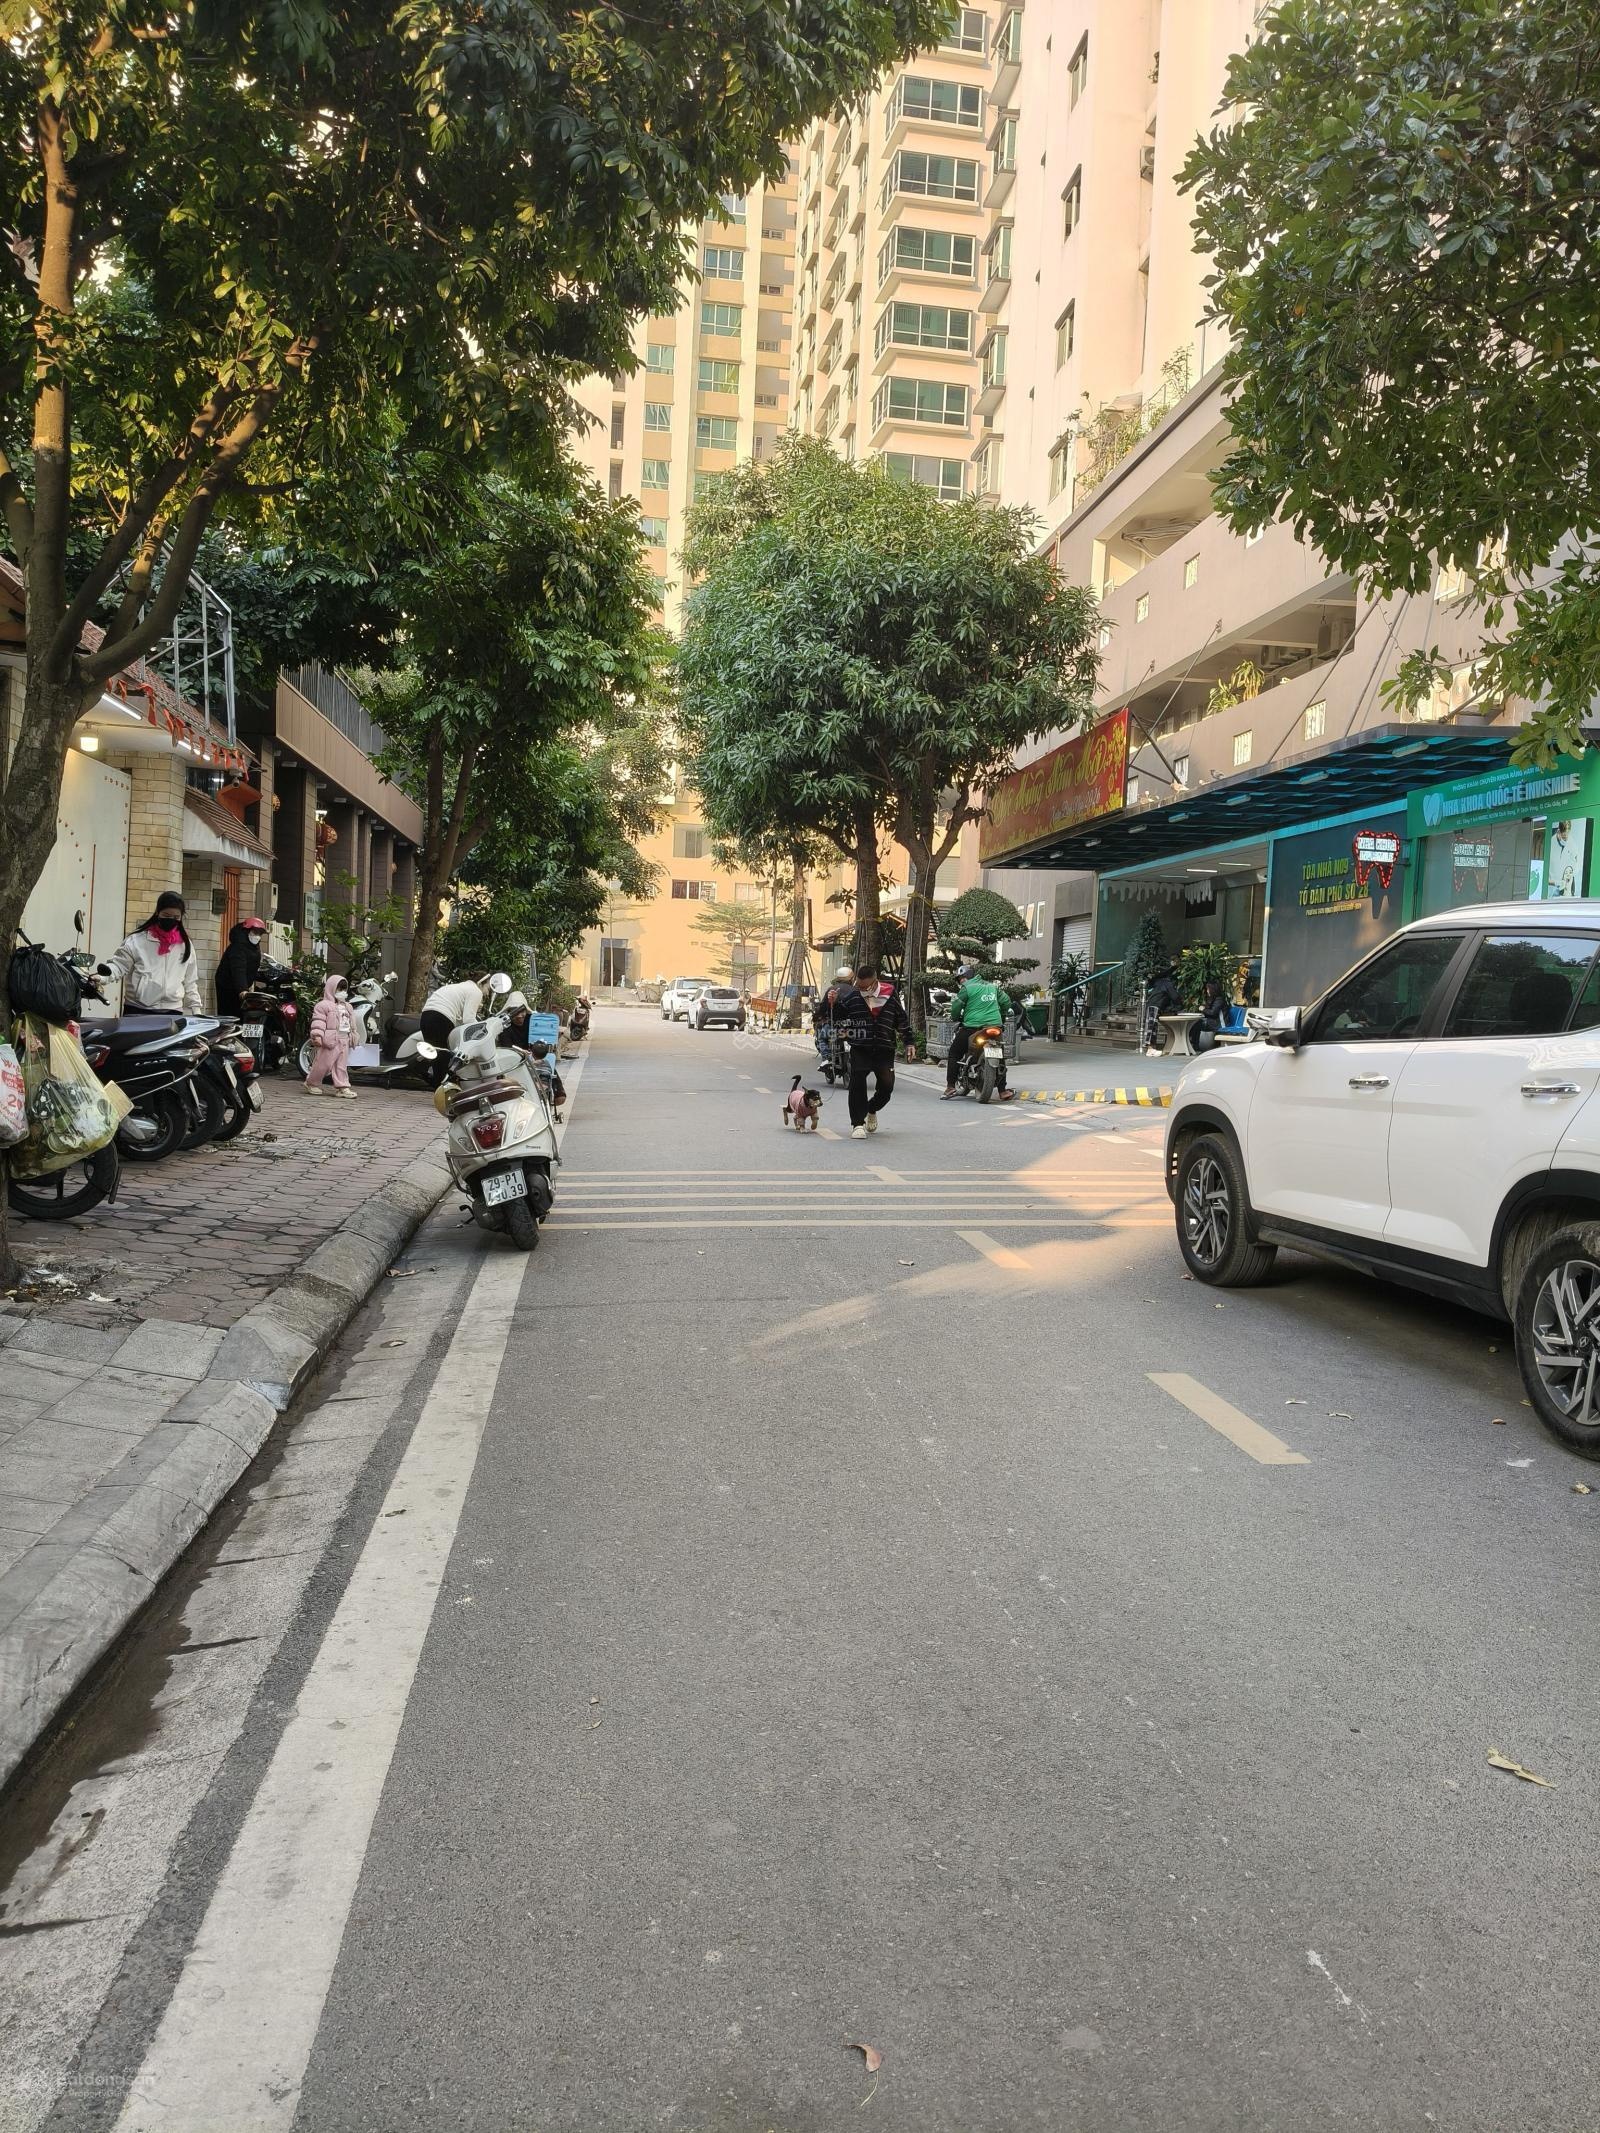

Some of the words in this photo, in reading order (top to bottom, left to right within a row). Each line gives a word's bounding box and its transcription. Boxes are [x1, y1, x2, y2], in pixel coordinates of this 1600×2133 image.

[1442, 798, 1459, 818] NHA
[1461, 795, 1486, 813] KHOA
[1486, 783, 1511, 809] QUỐC
[1525, 772, 1581, 801] INVISMILE
[1303, 861, 1315, 880] TÒA
[1317, 857, 1332, 878] NHÀ
